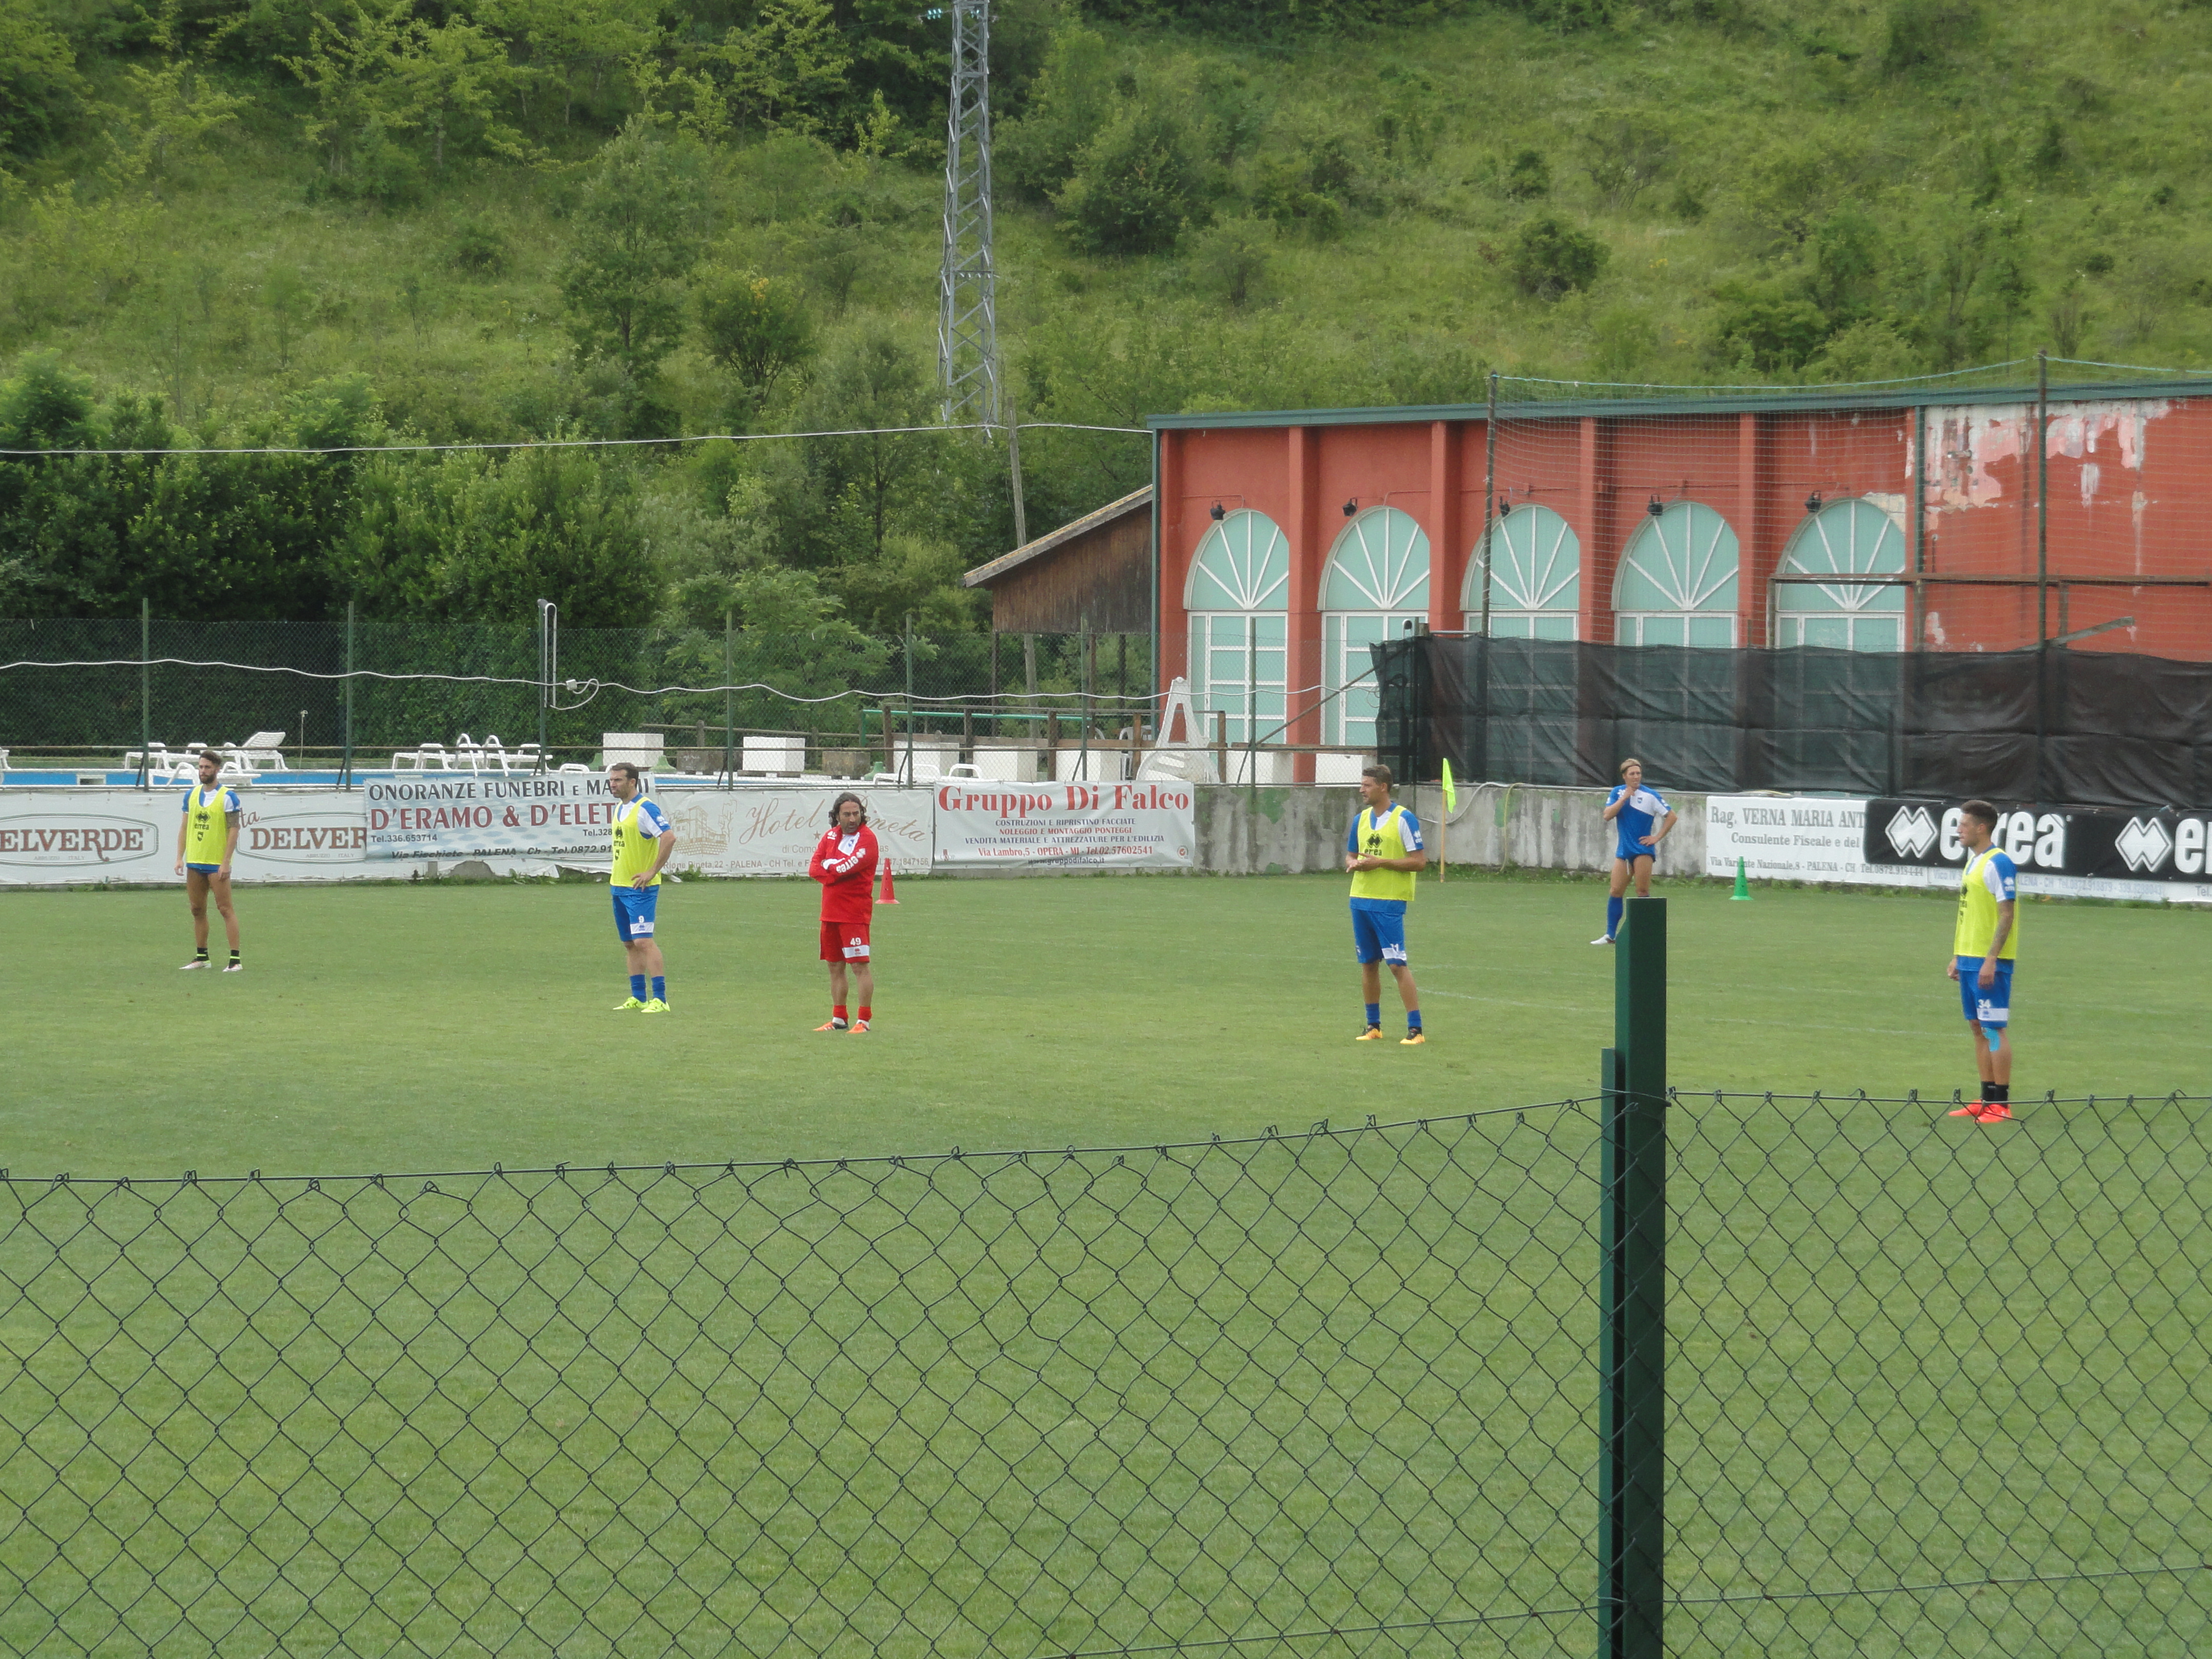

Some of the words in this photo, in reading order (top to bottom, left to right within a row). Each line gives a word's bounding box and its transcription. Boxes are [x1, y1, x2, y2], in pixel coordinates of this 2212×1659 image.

[369, 783, 477, 801] ONORANZE
[484, 780, 565, 798] FUNEBRI
[586, 778, 649, 795] MAI
[938, 785, 1053, 819] Gruppo
[1065, 785, 1099, 811] Di
[1112, 784, 1189, 810] Falco
[240, 807, 260, 828] ta
[371, 805, 493, 831] D'ERAMO
[502, 805, 521, 827] &
[530, 802, 619, 827] D'ELET
[738, 797, 825, 845] Hotel
[1710, 806, 1737, 828] Rag.
[1742, 807, 1786, 826] VERNA
[1790, 809, 1834, 827] MARIA
[1838, 811, 1865, 828] ANT
[582, 828, 612, 837] Tel.328
[371, 834, 438, 843] Tel.336.653714
[1731, 832, 1790, 846] Consulente
[1793, 835, 1831, 847] Fiscale
[1834, 839, 1841, 847] e
[1843, 837, 1860, 848] del
[472, 848, 517, 856] PALENA
[527, 847, 541, 855] Ch
[551, 845, 612, 854] Tel.0872.91
[782, 845, 789, 854] di
[978, 848, 991, 857] Via
[993, 847, 1030, 857] Lambro,5
[1037, 847, 1064, 856] OPERA
[1070, 847, 1079, 856] MI
[1086, 846, 1153, 855] Tel.02.57602541
[663, 861, 686, 869] Rione
[731, 860, 762, 868] PALENA
[804, 859, 810, 867] F
[1028, 857, 1104, 865] www.gruppodifalco.it
[1710, 856, 1722, 866] Via
[1724, 857, 1755, 868] Varinte
[1757, 859, 1800, 871] Nazionale,8
[1806, 861, 1838, 871] PALENA
[1845, 862, 1856, 873] CH
[850, 938, 861, 946] 49
[1978, 999, 1991, 1008] 34
